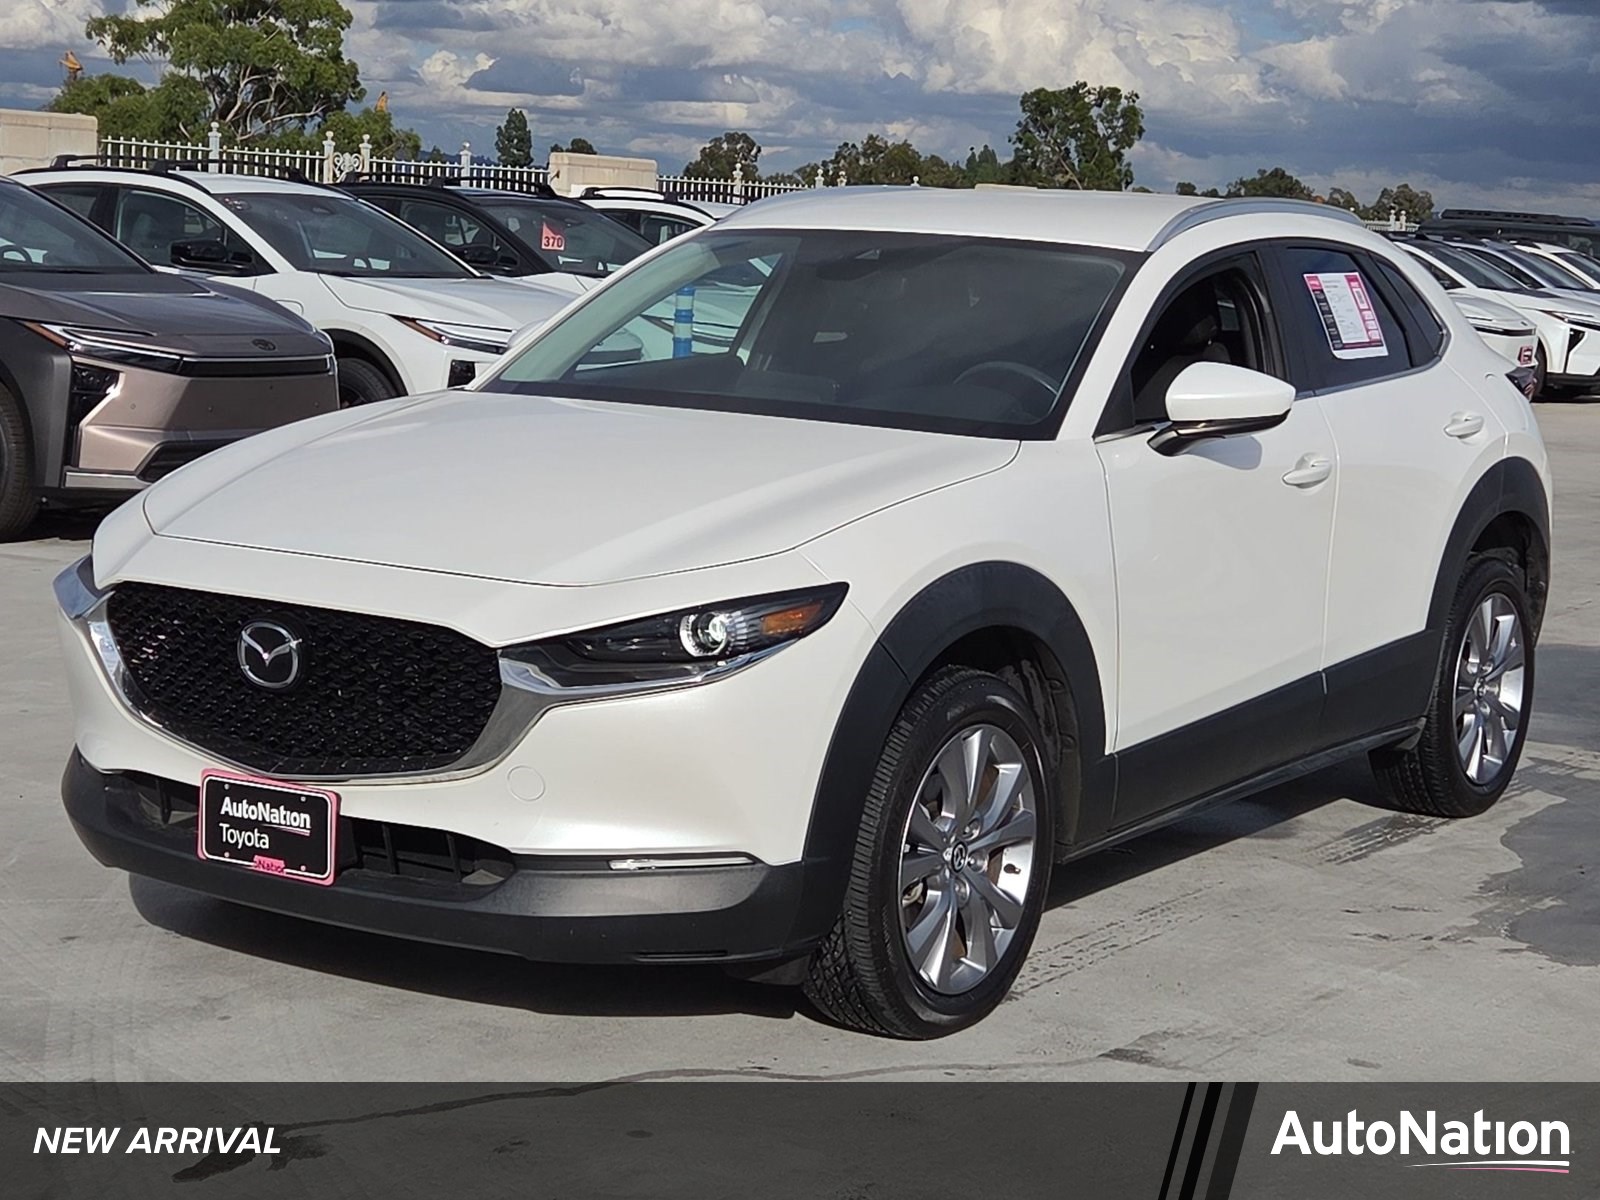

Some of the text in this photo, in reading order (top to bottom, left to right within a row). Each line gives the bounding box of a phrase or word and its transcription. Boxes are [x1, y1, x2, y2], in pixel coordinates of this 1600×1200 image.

[543, 236, 563, 248] 370
[219, 796, 312, 829] AutoNation
[218, 822, 270, 849] Toyota
